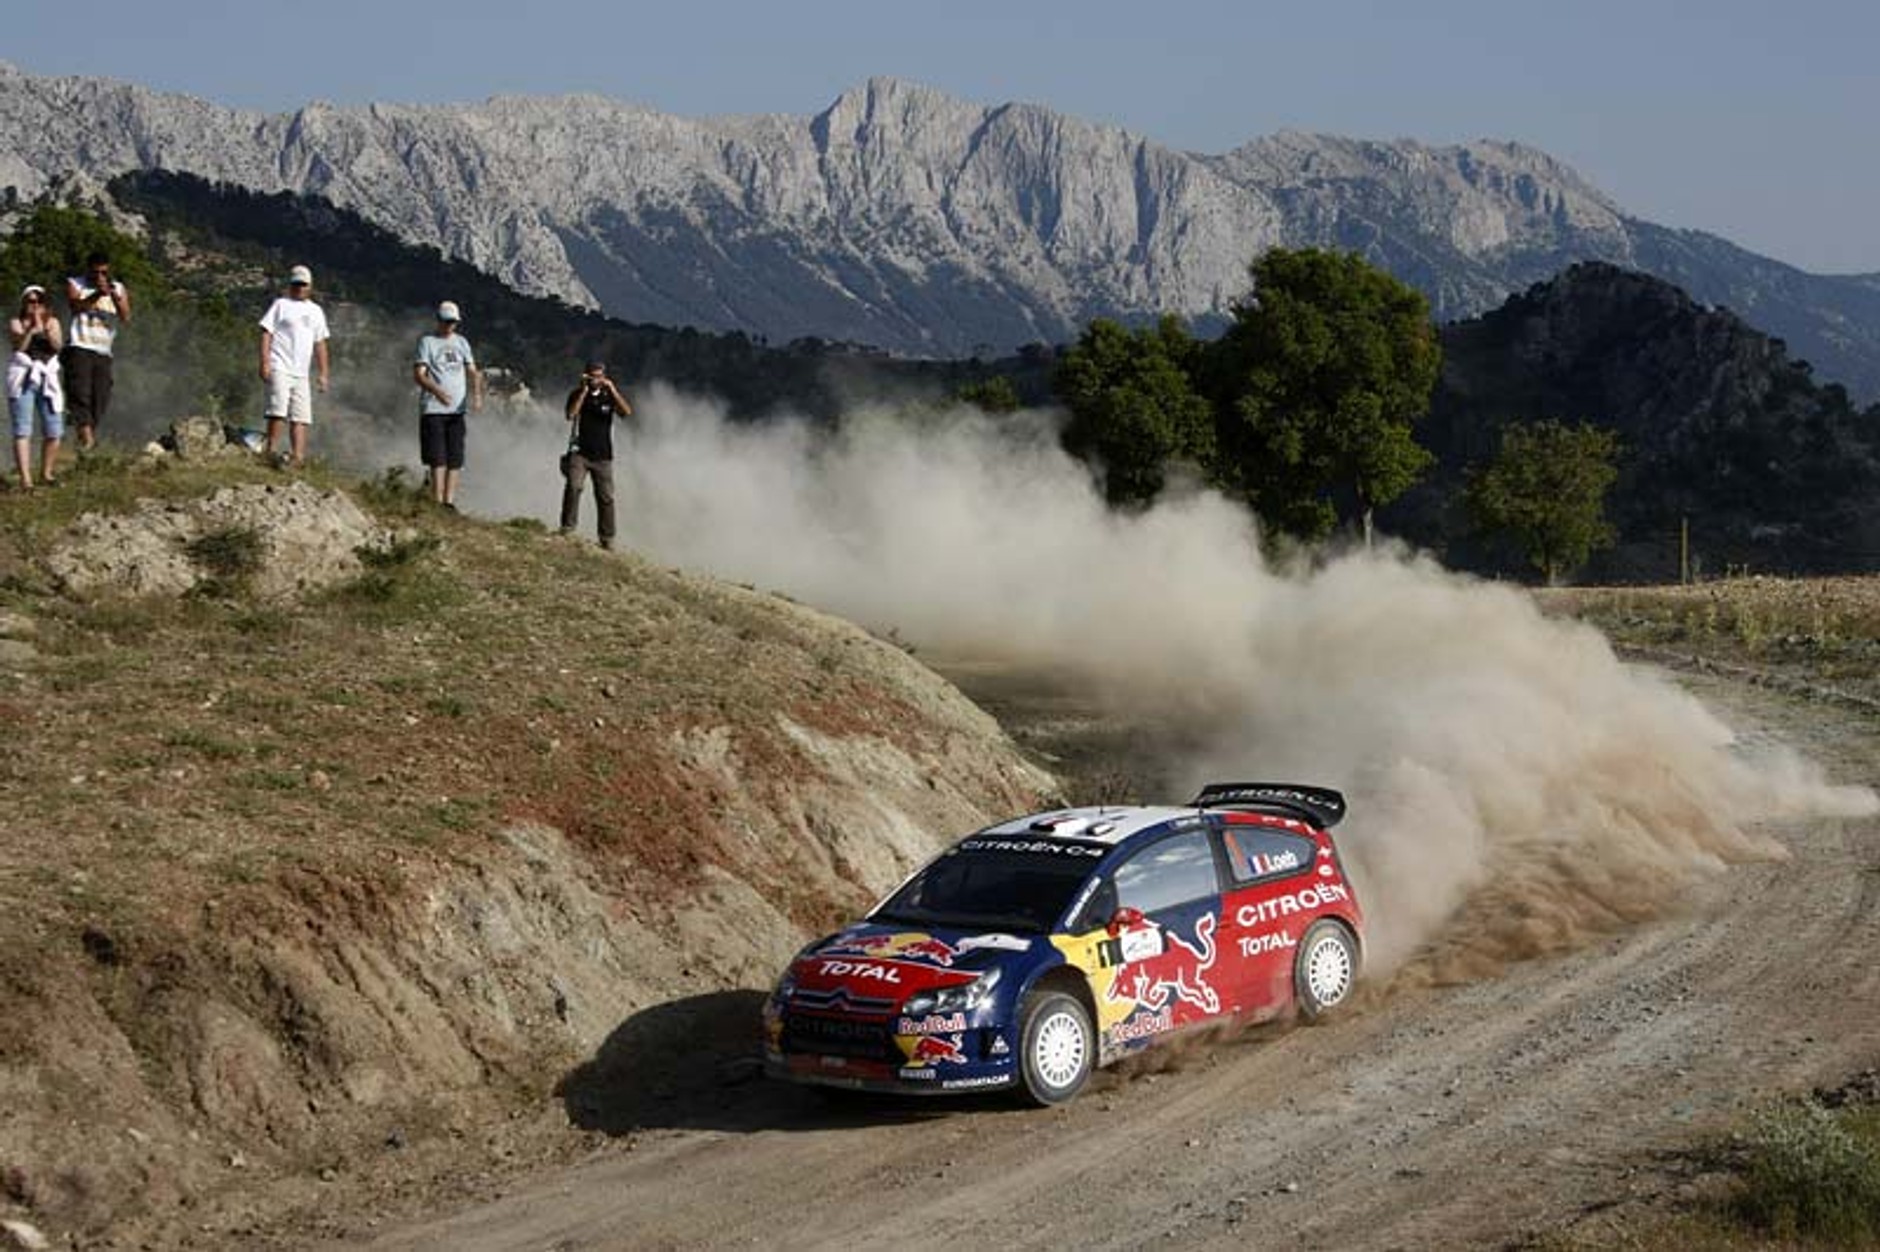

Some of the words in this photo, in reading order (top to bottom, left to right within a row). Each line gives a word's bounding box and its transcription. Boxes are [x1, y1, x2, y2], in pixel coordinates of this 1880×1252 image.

[1265, 850, 1298, 872] Loeb
[1236, 882, 1350, 927] CITROËN
[1237, 931, 1297, 957] TOTAL
[819, 960, 902, 984] TOTAL
